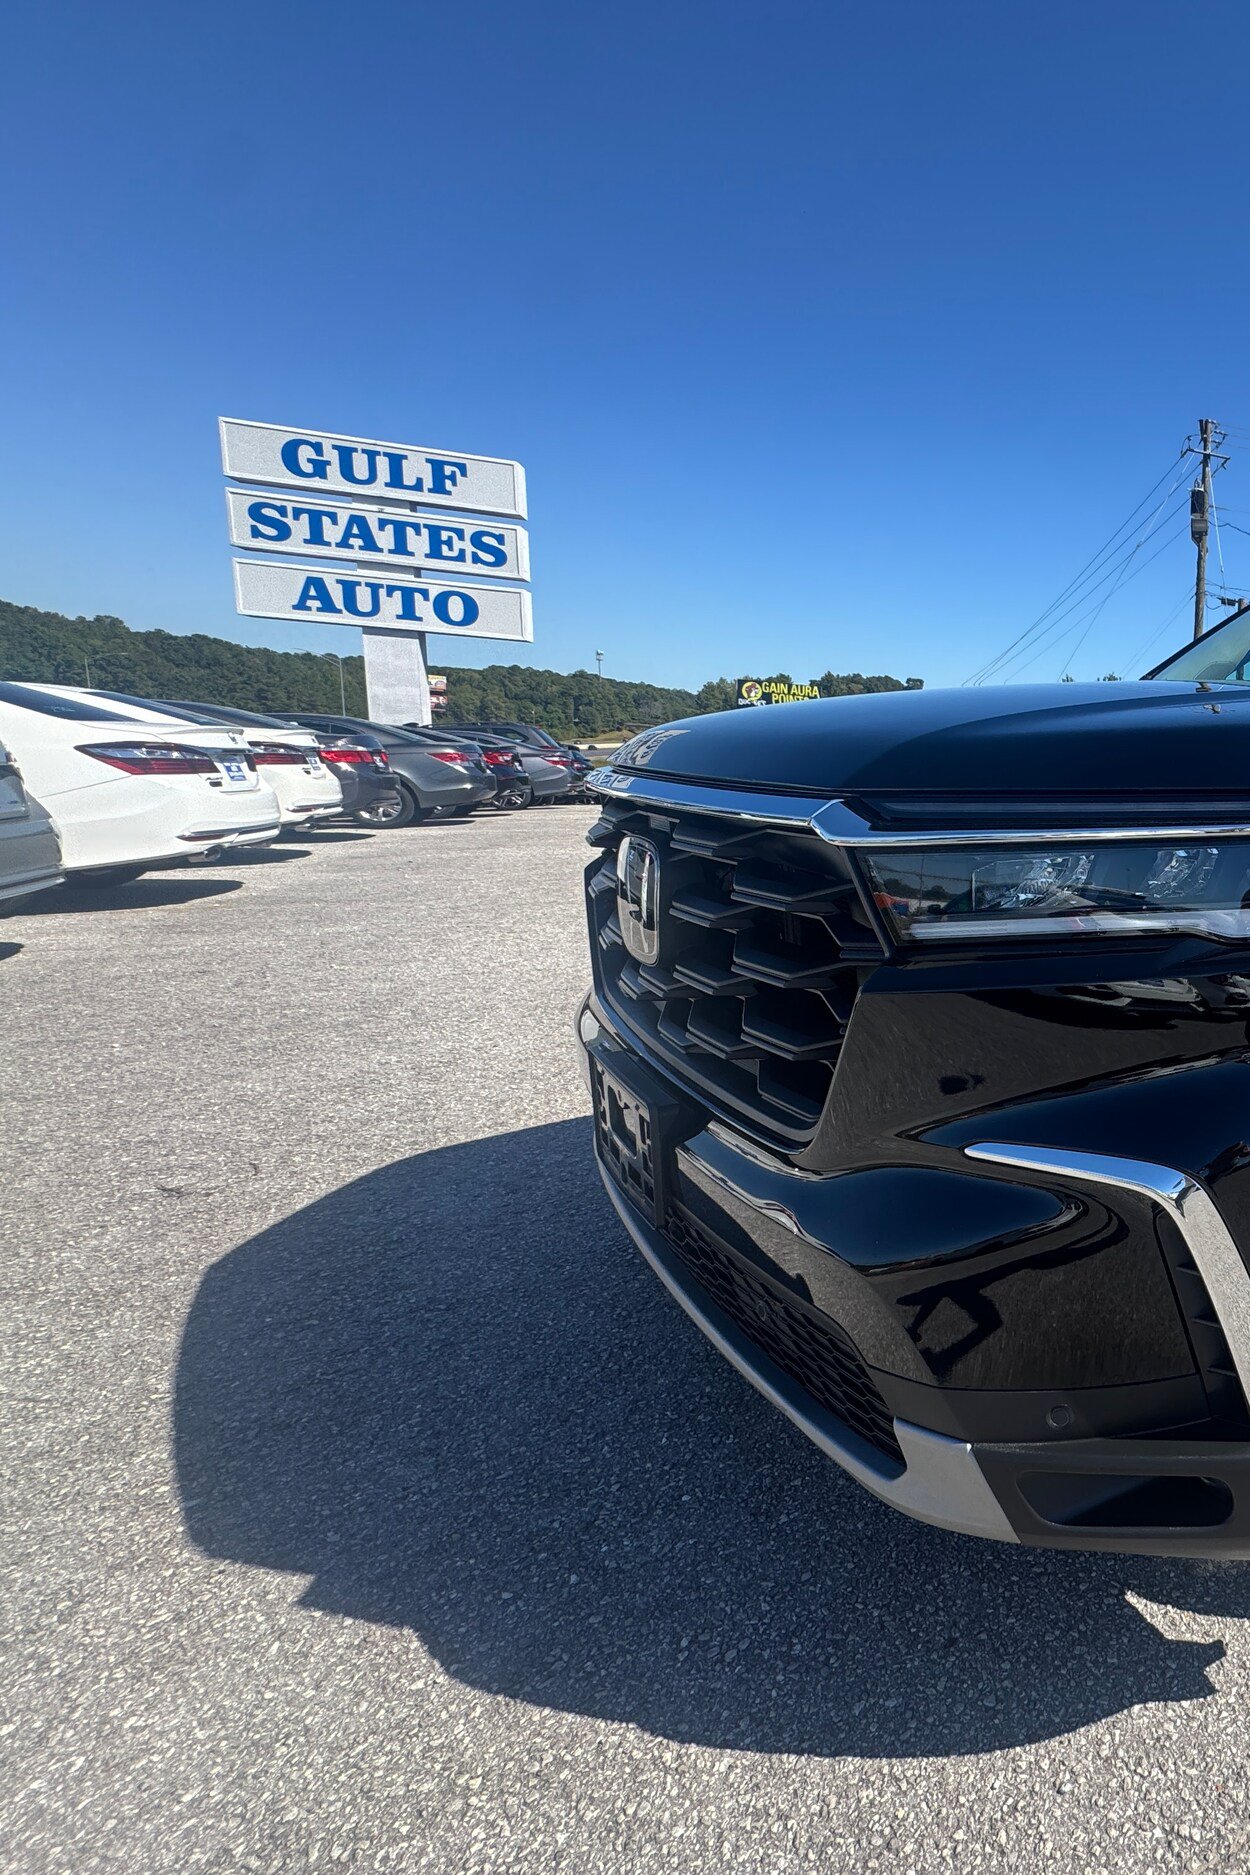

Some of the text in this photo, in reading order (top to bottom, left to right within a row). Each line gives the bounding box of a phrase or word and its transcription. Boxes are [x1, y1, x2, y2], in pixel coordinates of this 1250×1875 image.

[281, 438, 467, 496] GULF
[247, 501, 507, 568] STATES
[292, 576, 479, 627] AUTO
[762, 681, 820, 699] GAIN AURA
